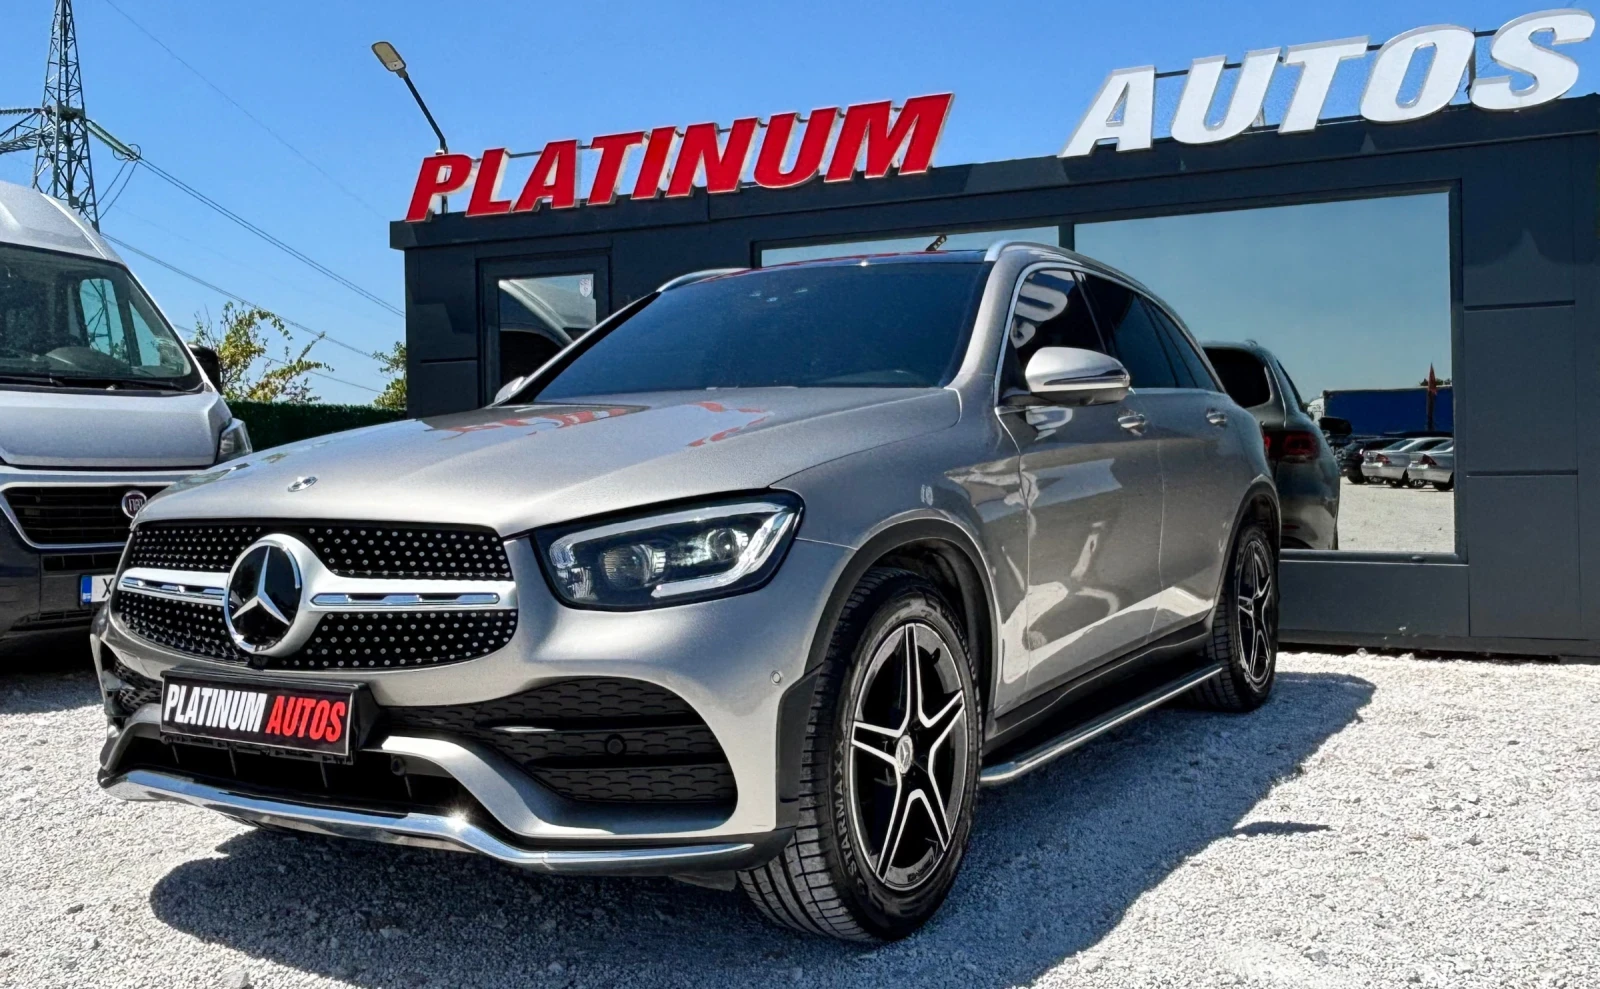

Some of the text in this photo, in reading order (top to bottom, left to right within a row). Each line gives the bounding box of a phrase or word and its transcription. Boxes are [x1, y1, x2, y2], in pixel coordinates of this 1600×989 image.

[405, 8, 1596, 222] PLATINUM AUTOS
[163, 684, 346, 743] PLATINUM AUTOS
[834, 740, 857, 876] STARMAXX
